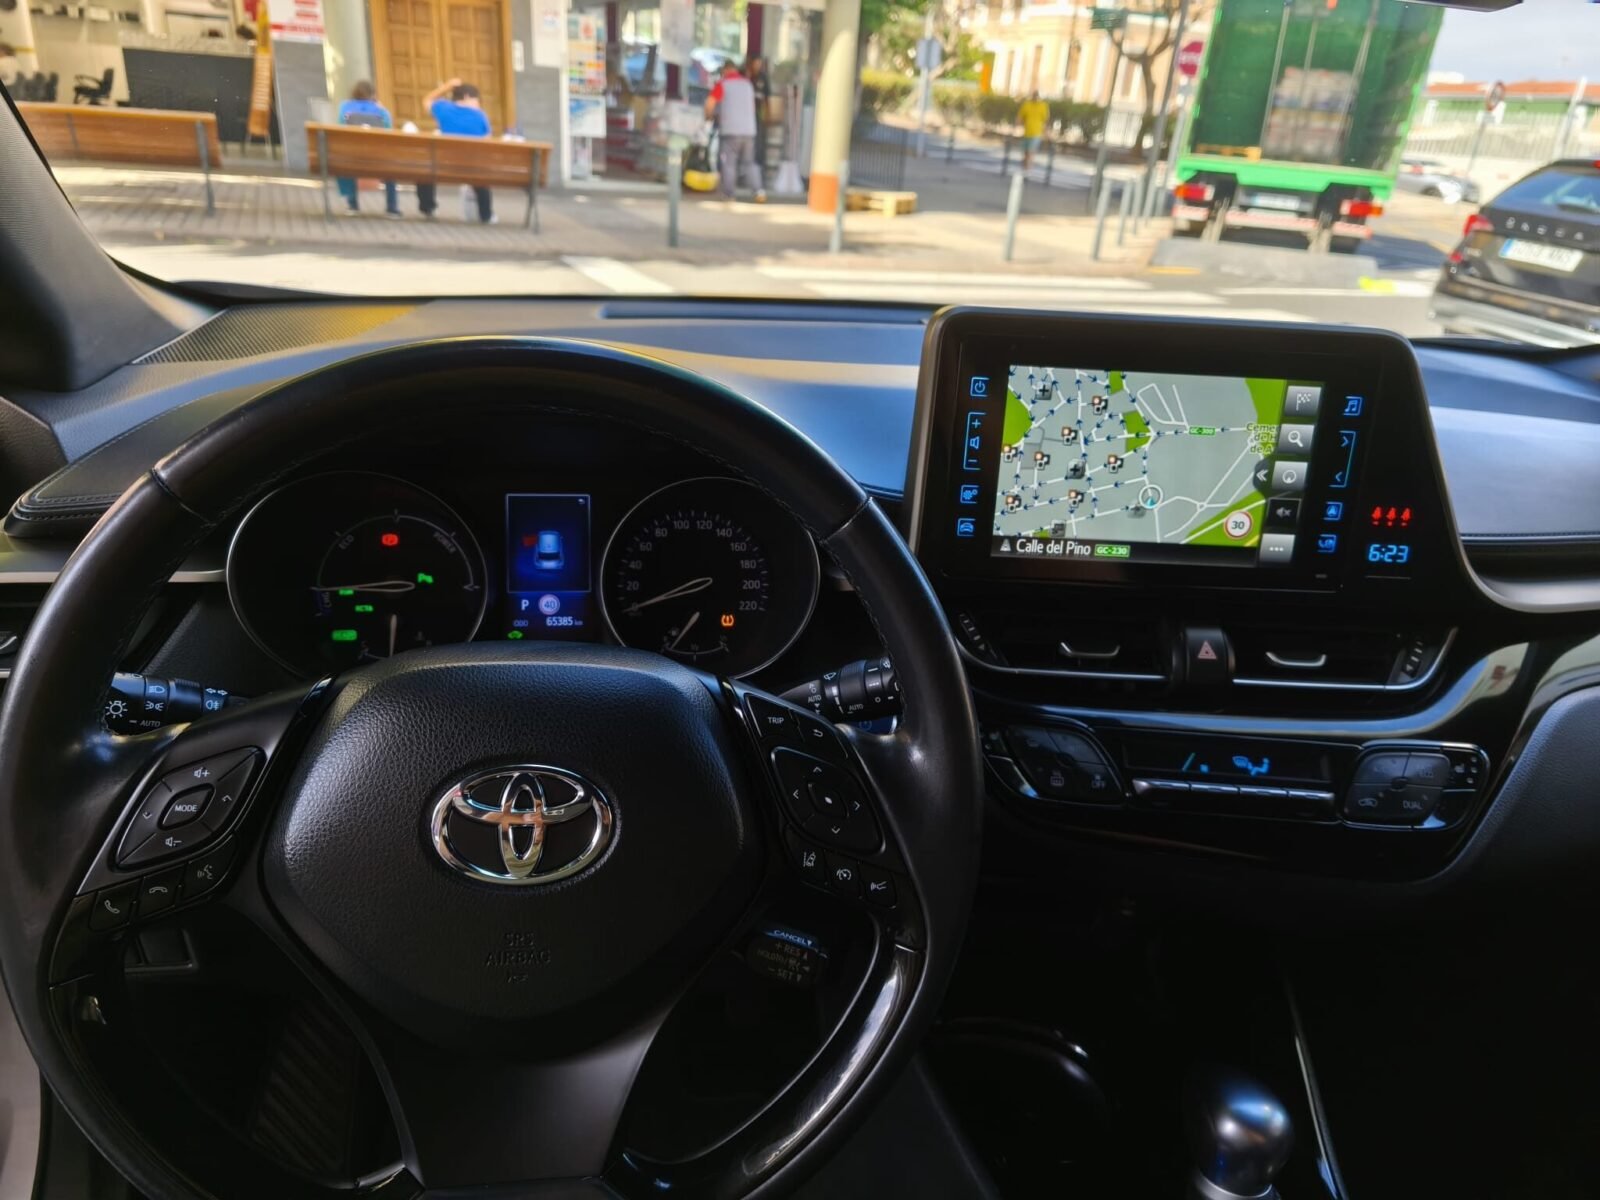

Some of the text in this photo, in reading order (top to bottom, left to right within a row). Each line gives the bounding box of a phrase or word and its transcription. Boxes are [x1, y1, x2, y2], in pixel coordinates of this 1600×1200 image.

[673, 520, 690, 530] 100
[696, 520, 713, 530] 120
[1231, 520, 1245, 530] 30
[655, 528, 668, 537] 80
[716, 528, 732, 537] 140
[639, 542, 653, 552] 60
[730, 542, 747, 552] 160
[1015, 539, 1127, 557] Calle del Pino GC-230
[1368, 544, 1409, 563] 6:23
[628, 560, 643, 570] 40
[740, 560, 757, 569] 180
[626, 581, 640, 591] 20
[742, 580, 761, 590] 200
[521, 599, 530, 611] P
[543, 600, 557, 610] 40
[739, 601, 758, 611] 220
[545, 616, 574, 627] 65385
[807, 694, 822, 703] AUTO
[140, 719, 161, 728] AUTO
[768, 716, 784, 725] TRIP
[174, 804, 198, 812] MODE
[1402, 800, 1424, 811] DUAL
[773, 929, 807, 945] CANCEL
